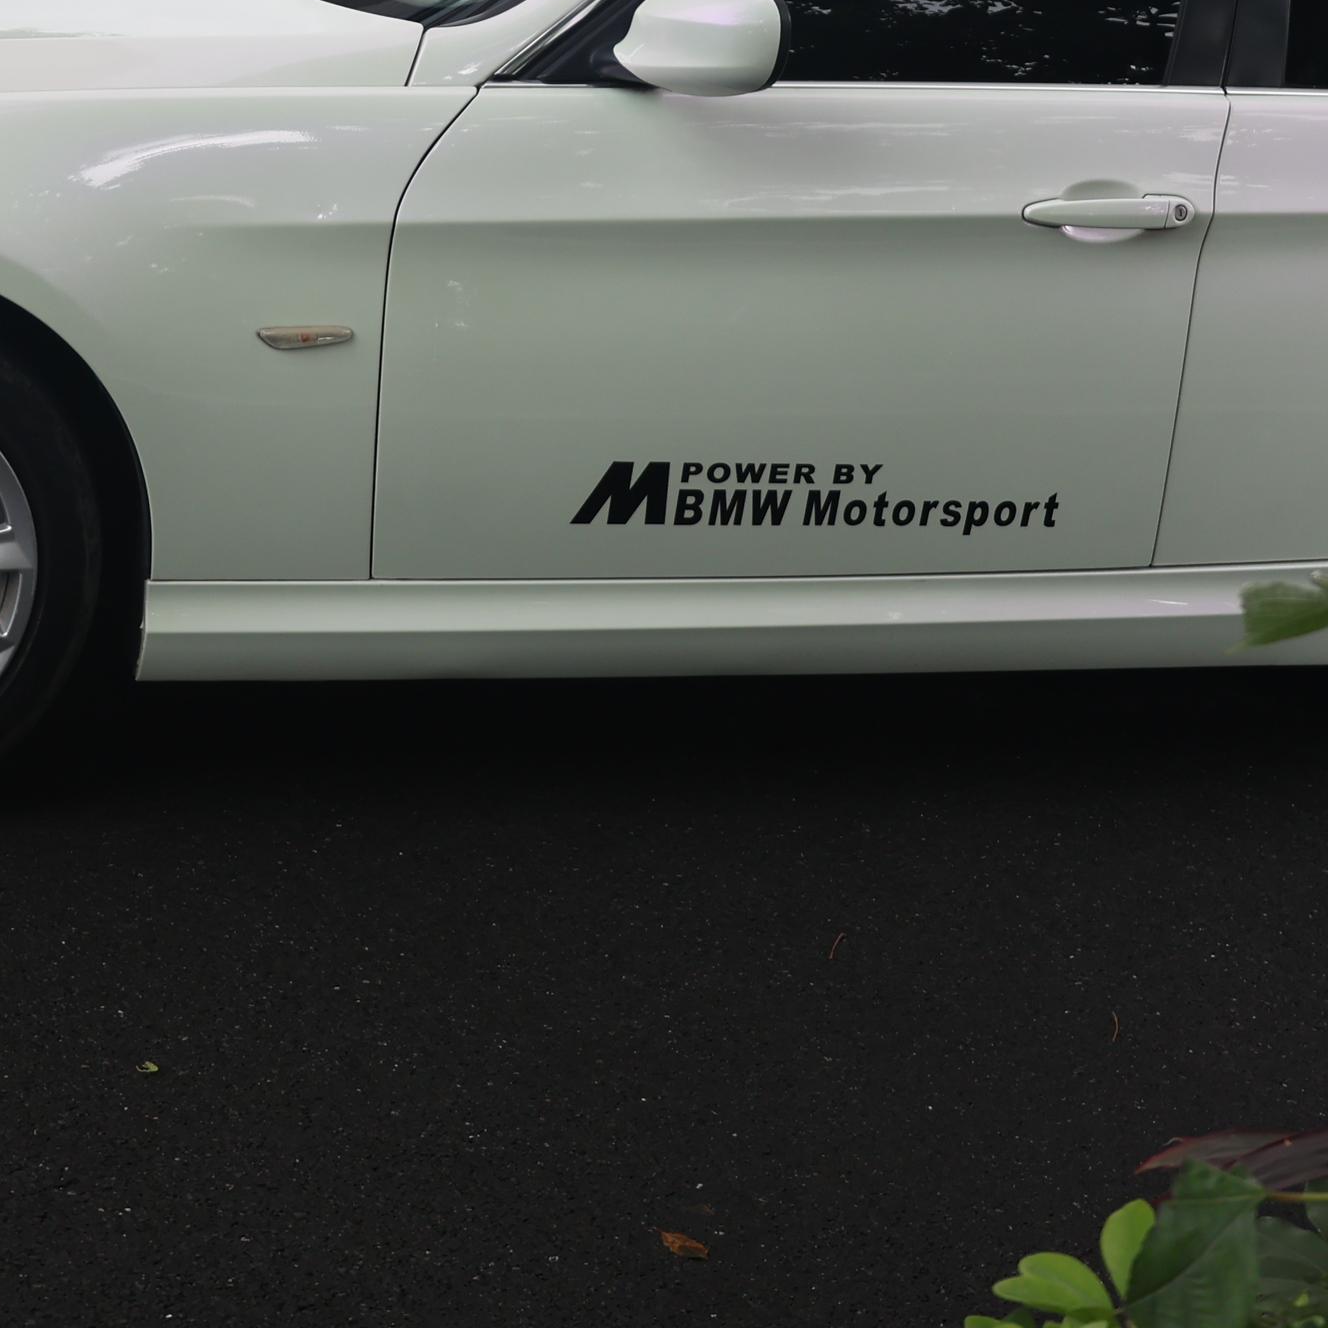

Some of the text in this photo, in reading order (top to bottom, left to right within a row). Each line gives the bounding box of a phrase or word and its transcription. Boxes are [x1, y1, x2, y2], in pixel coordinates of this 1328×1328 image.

[570, 461, 671, 525] M
[680, 462, 884, 485] POWER BY
[673, 488, 1060, 536] BMW Motorsport
